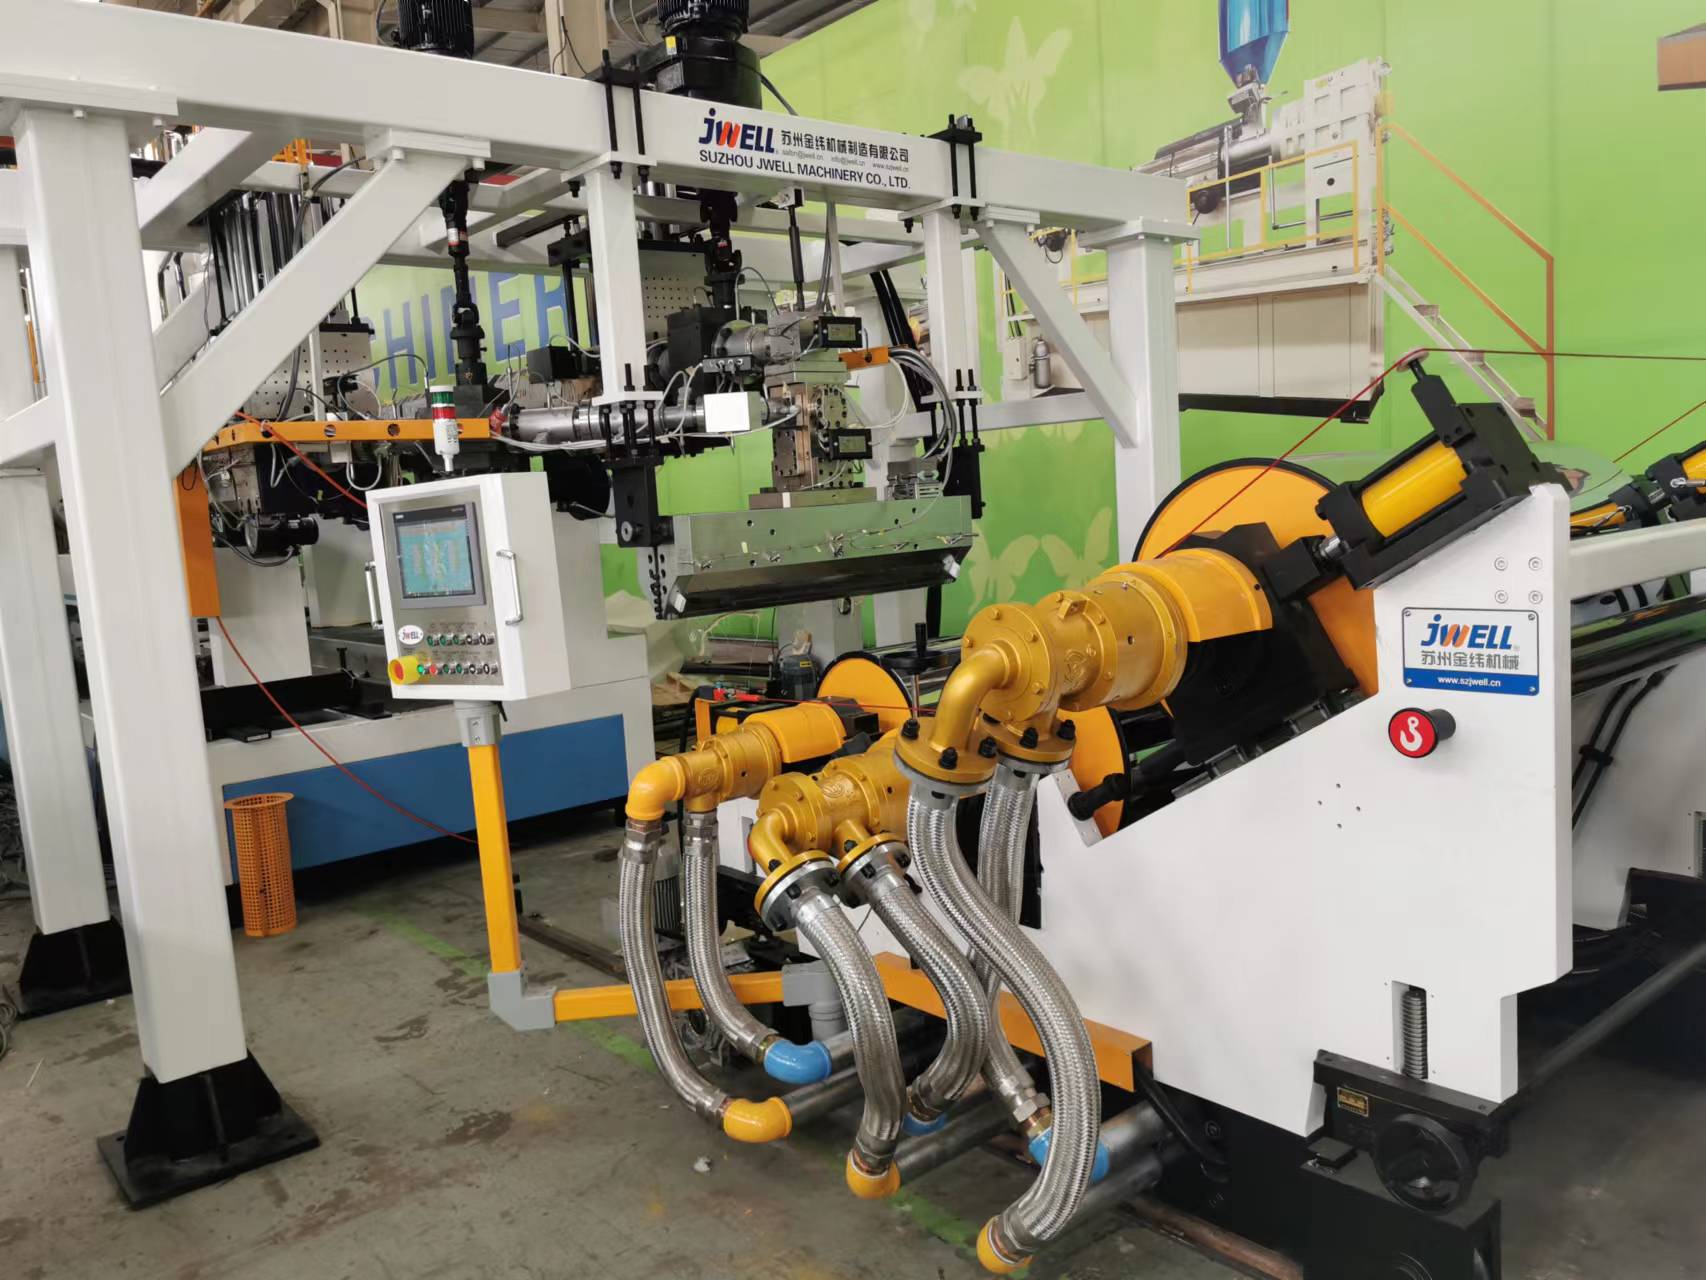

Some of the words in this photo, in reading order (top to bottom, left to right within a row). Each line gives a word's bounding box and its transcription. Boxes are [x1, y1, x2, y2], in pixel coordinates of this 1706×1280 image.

[781, 130, 909, 163] 苏州金纬机械制造有限公司
[699, 149, 753, 168] SUZHOU
[756, 157, 795, 174] JWELL
[797, 163, 864, 183] MACHINERY
[866, 172, 887, 187] CO.,
[889, 176, 911, 190] LTD.
[1420, 650, 1520, 671] 苏州金纬机械
[1438, 676, 1501, 687] www.szjwell.cn
